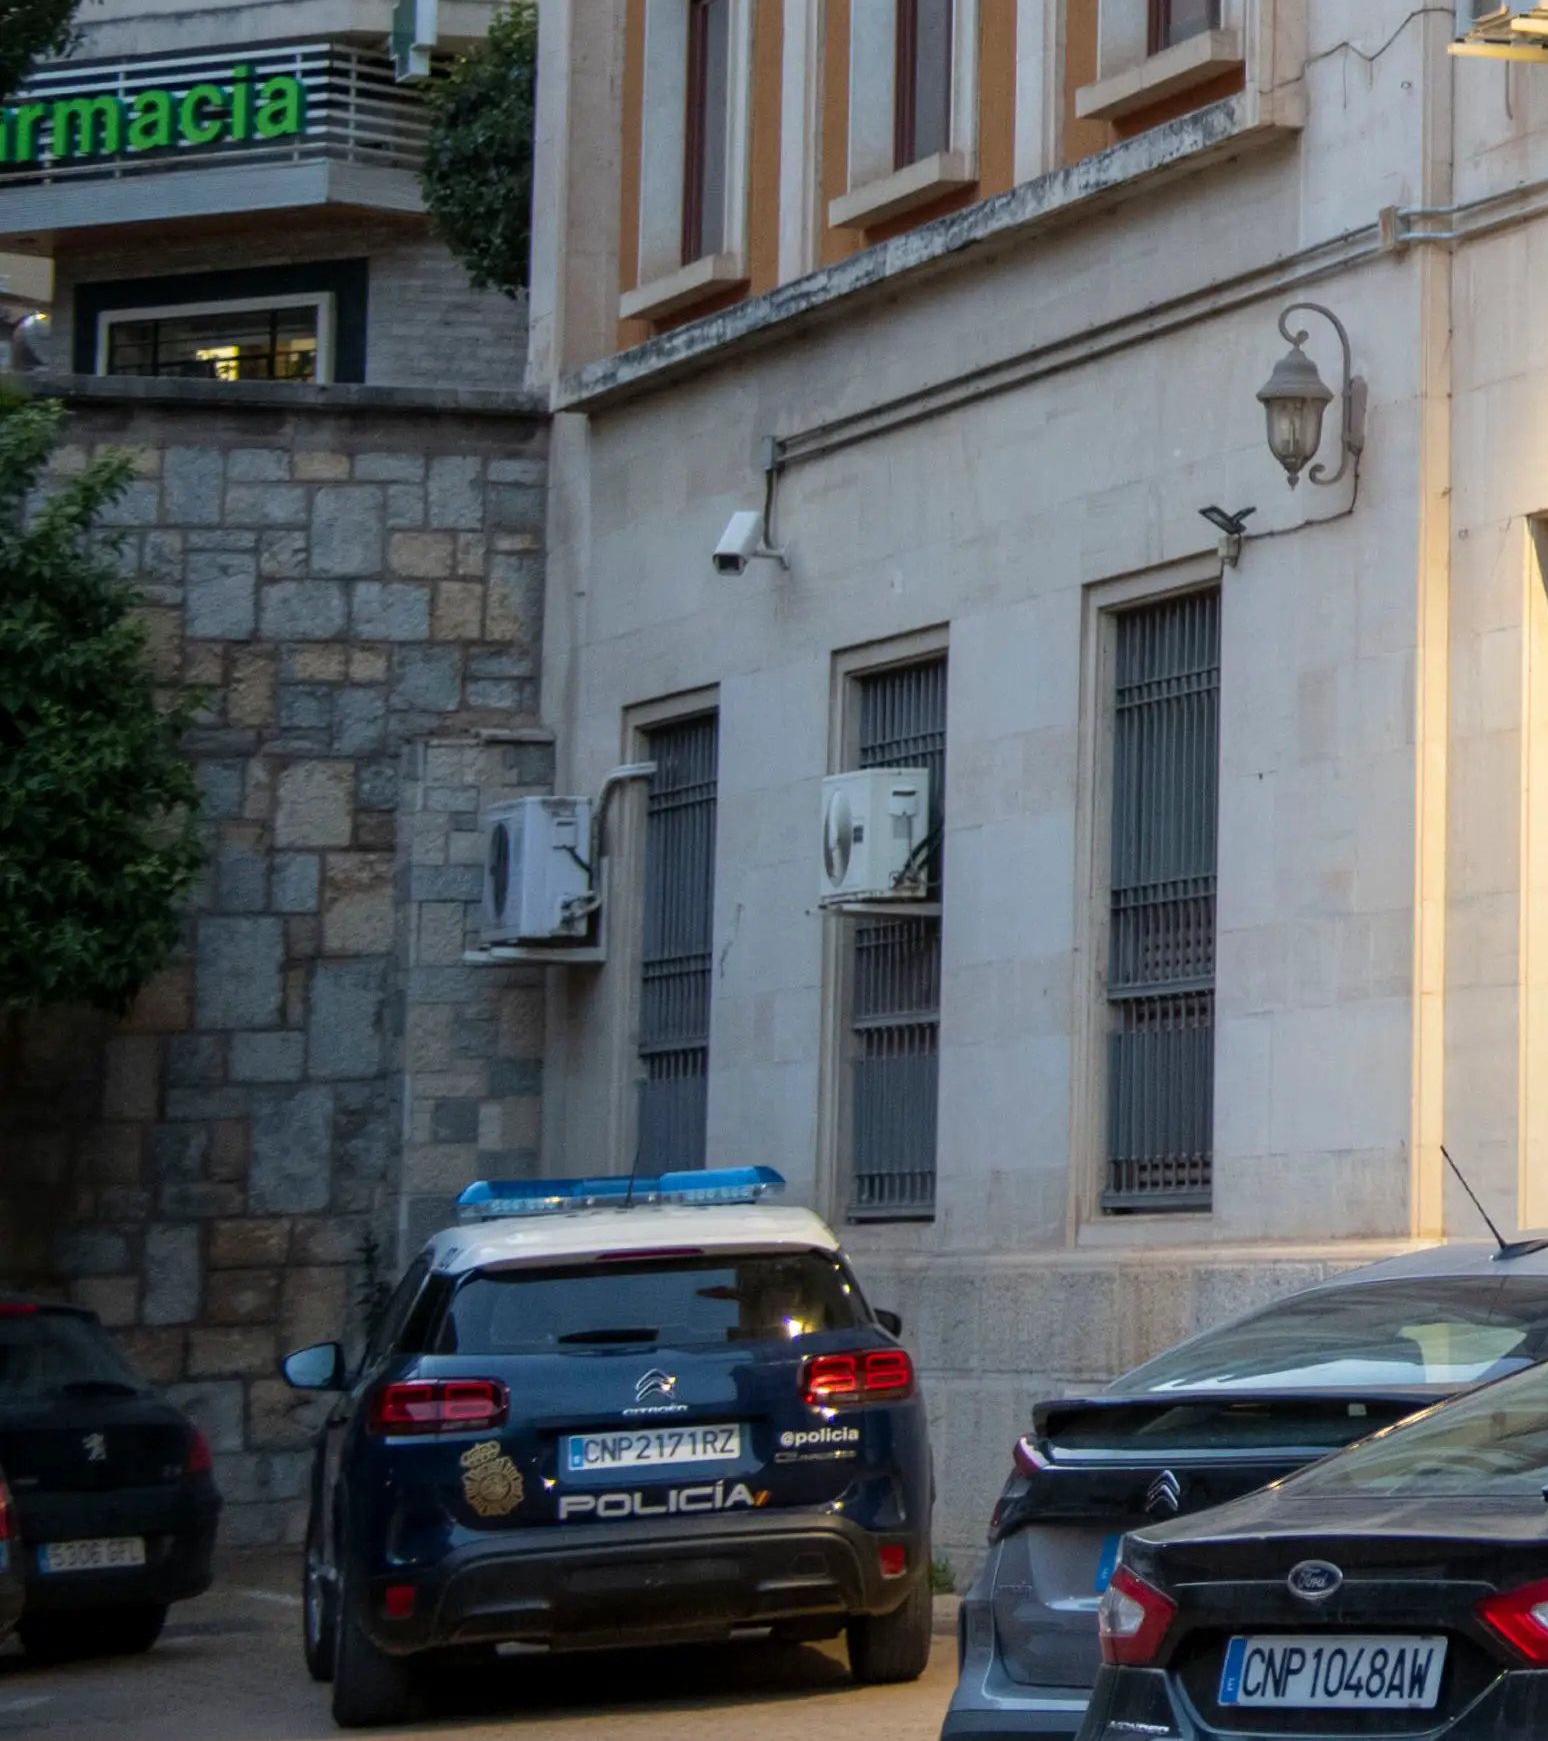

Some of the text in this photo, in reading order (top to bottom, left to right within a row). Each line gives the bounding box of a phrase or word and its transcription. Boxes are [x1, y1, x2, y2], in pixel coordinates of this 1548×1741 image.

[0, 65, 306, 162] rmacia
[583, 1428, 736, 1464] CNP2171RZ
[779, 1425, 859, 1449] @policia
[558, 1481, 755, 1521] POLICÍA
[1297, 1567, 1328, 1590] Ford
[1242, 1647, 1434, 1698] CNP1048AW
